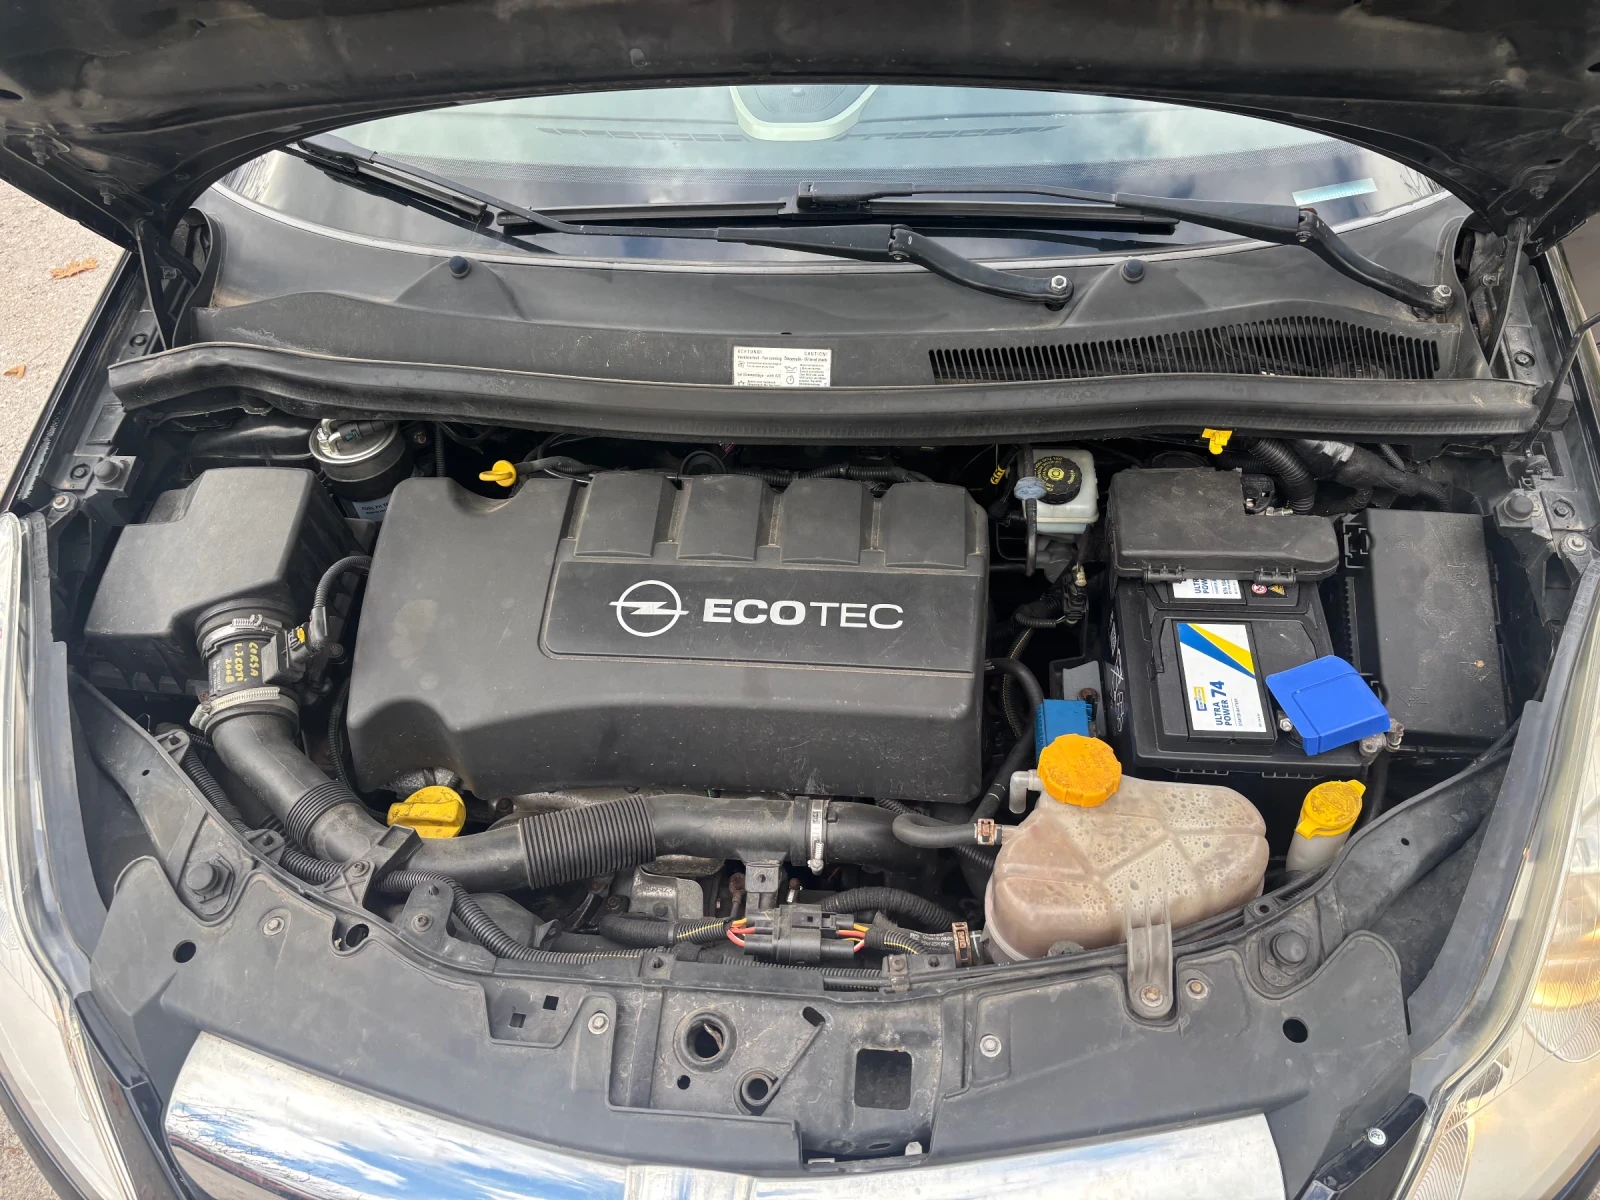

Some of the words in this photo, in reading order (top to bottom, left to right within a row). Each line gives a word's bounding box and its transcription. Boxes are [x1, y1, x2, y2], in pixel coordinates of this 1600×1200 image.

[1193, 578, 1202, 594] ULTR
[1201, 578, 1210, 594] POW
[702, 597, 904, 630] ECOTEC
[248, 641, 260, 677] CORSA
[1209, 680, 1227, 697] 74
[1212, 702, 1223, 726] ULTRA
[1221, 699, 1232, 726] POWER
